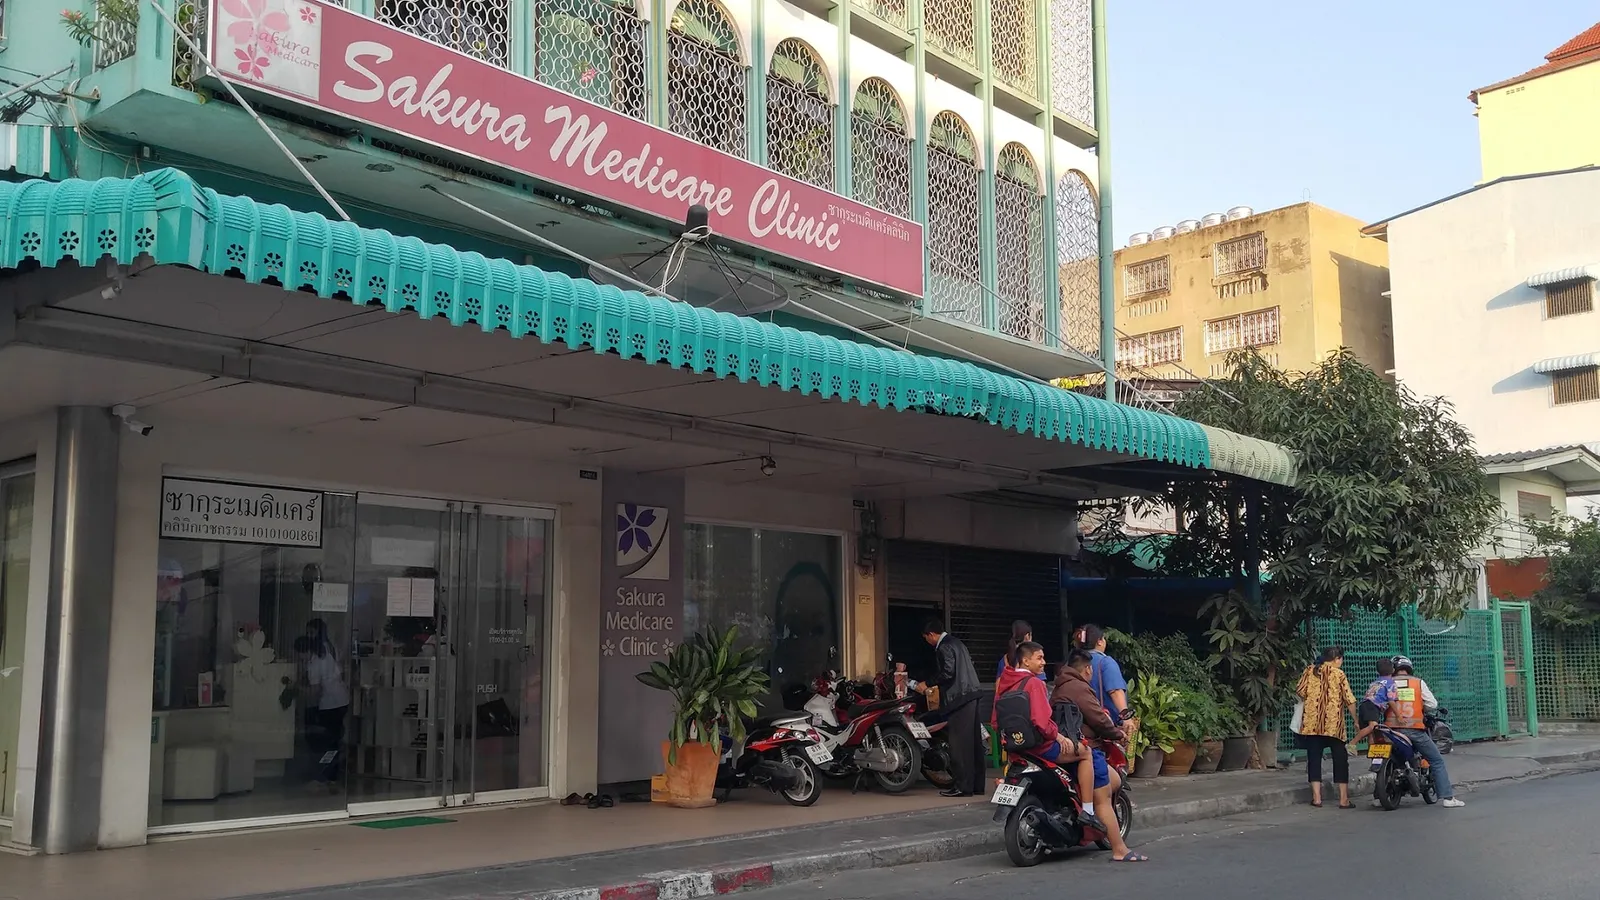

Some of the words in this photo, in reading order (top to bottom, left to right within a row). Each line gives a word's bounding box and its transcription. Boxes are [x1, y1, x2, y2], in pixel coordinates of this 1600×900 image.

[333, 41, 531, 151] Sakura
[544, 105, 734, 217] Medicare
[748, 178, 841, 251] Clinic
[165, 491, 319, 522] ซากุระเมดิแคร์
[163, 516, 247, 537] คลินิกเวชกรรม
[251, 526, 318, 542] 10101001861
[616, 586, 666, 606] Sakura
[606, 611, 674, 631] Medicare
[619, 636, 658, 656] Clinic
[477, 684, 498, 693] PUSH
